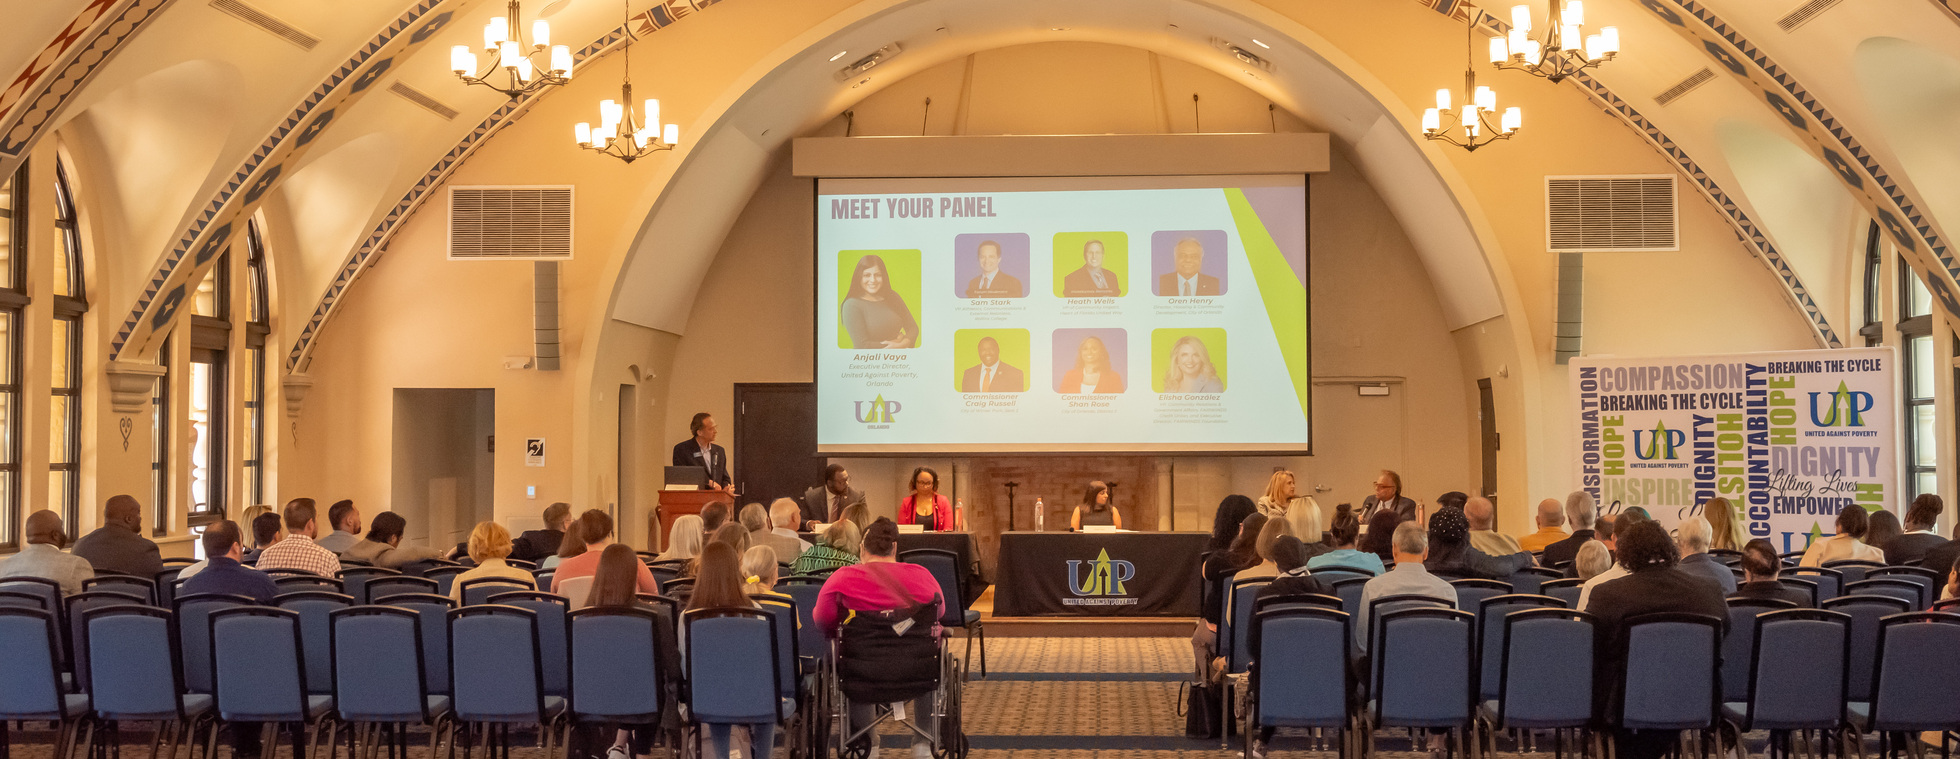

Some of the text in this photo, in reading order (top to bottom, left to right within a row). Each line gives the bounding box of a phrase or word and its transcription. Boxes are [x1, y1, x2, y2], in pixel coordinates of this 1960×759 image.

[831, 196, 997, 220] MEET YOUR PANEL
[853, 353, 907, 362] Anjali Vaya
[1768, 358, 1882, 374] BREAKING THE CYCLE
[890, 371, 919, 379] Poverty,
[1599, 363, 1743, 393] COMPASSION
[853, 400, 902, 423] UP
[965, 400, 987, 408] Craig
[1600, 392, 1744, 412] BREAKING THE CYCLE
[1769, 375, 1797, 445] HOPE
[1807, 391, 1874, 428] UP
[1579, 367, 1600, 510] NSFORMATION
[1602, 415, 1625, 475] HOPE
[1632, 429, 1686, 460] UP
[1745, 362, 1771, 543] CCOUNTABILITY
[1692, 413, 1716, 505] DIGNITY
[1716, 413, 1745, 521] HOLIST
[1771, 445, 1881, 478] DIGNITY
[1603, 477, 1693, 506] INSPIRE
[1763, 468, 1860, 499] Lifting Lives
[1066, 559, 1135, 596] UP
[1062, 598, 1084, 606] UNITED
[1085, 598, 1110, 606] AGAINST
